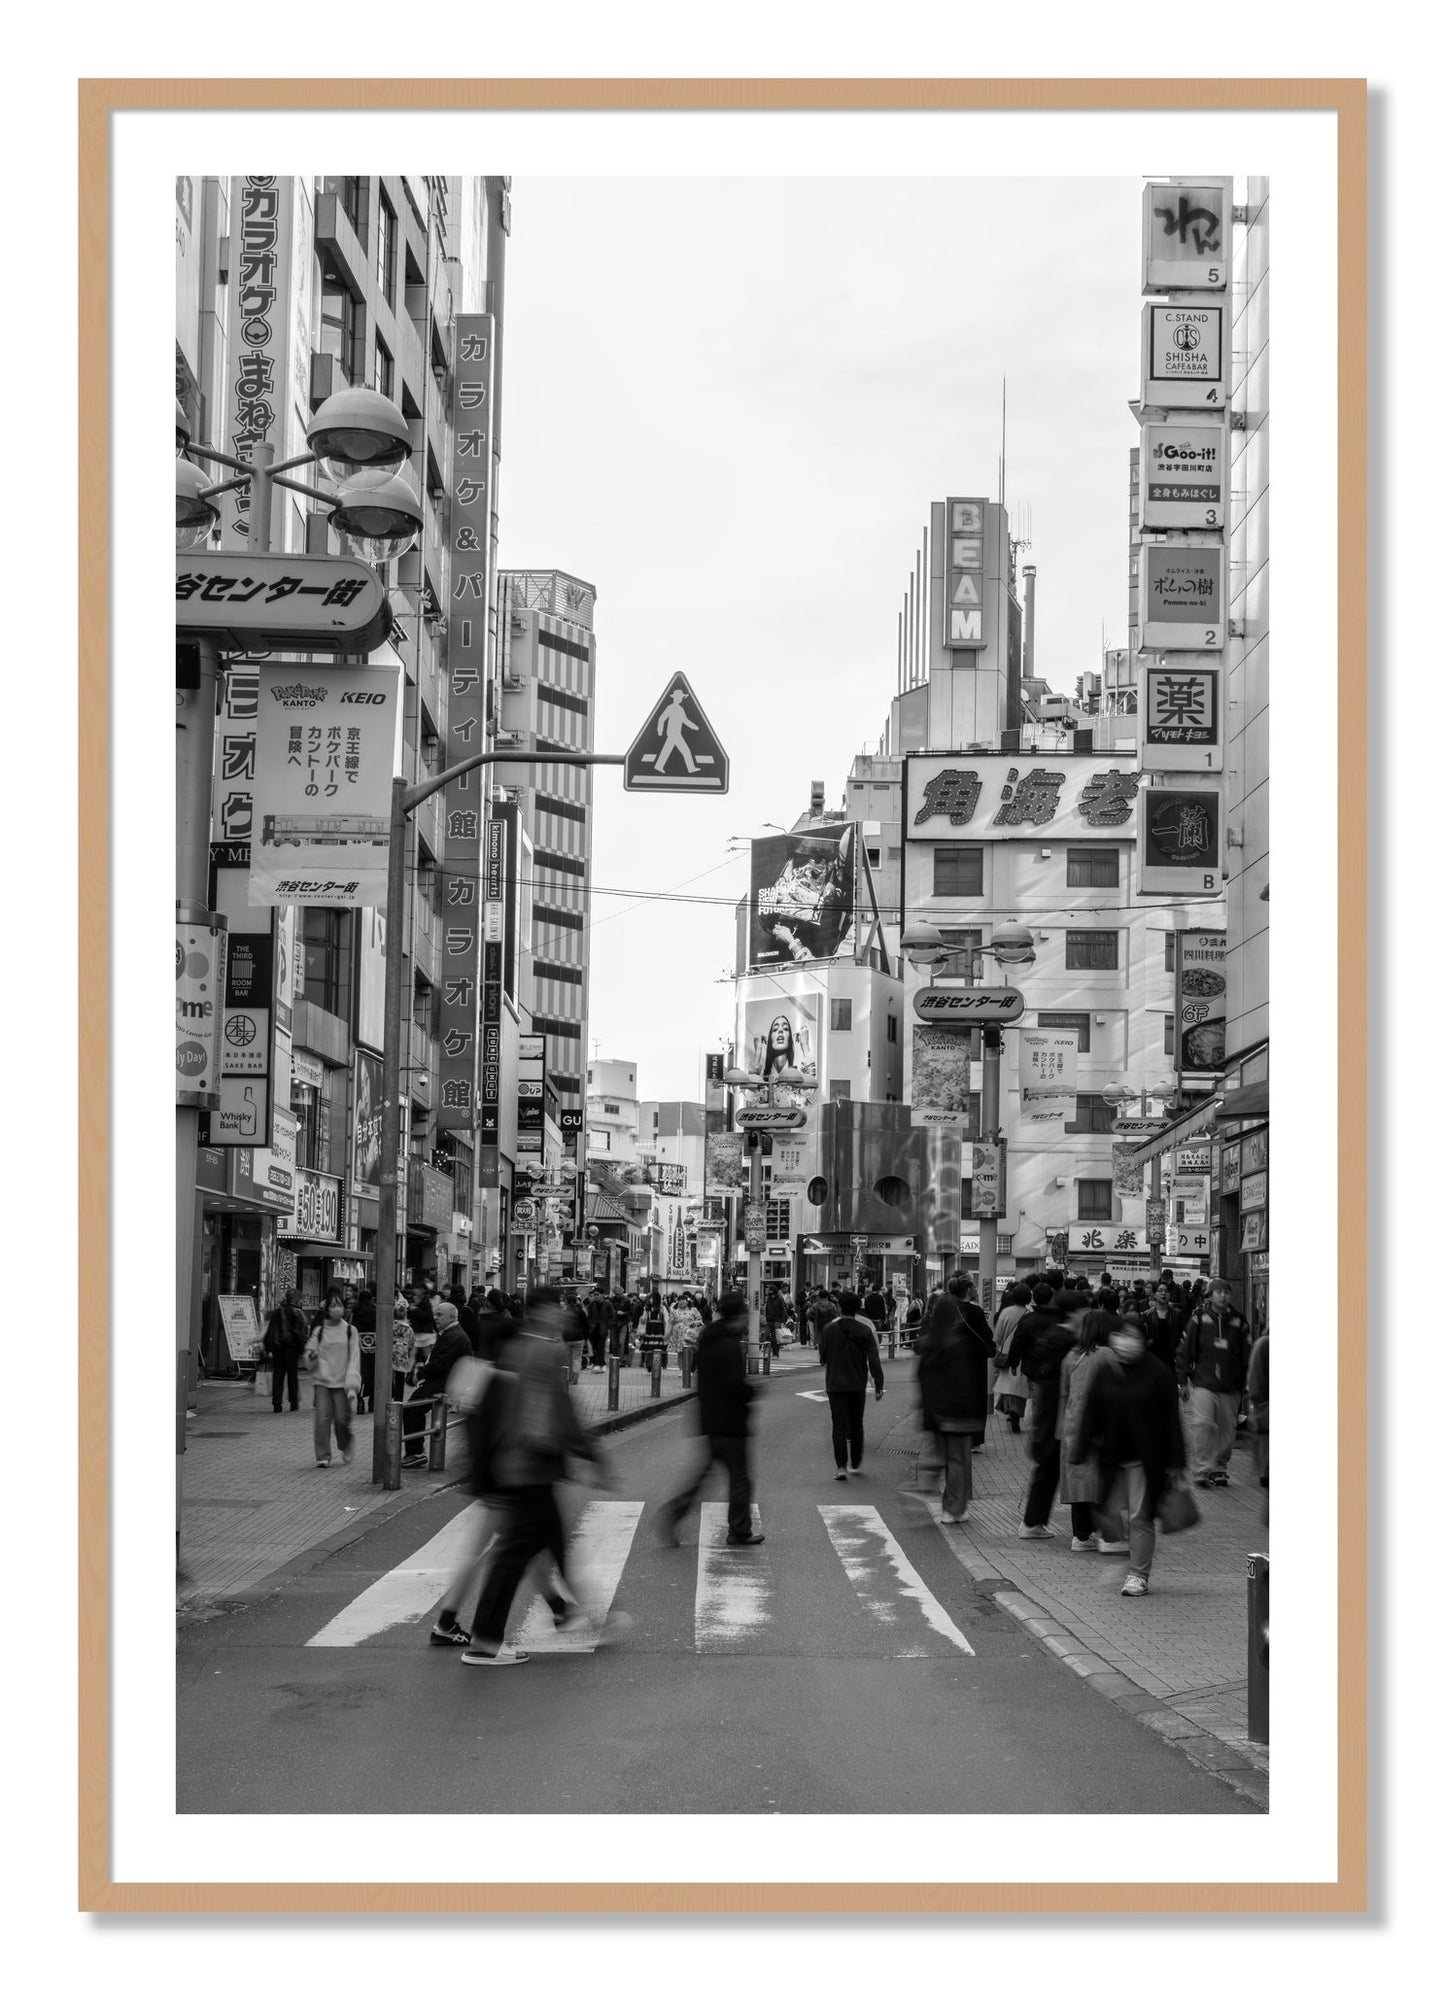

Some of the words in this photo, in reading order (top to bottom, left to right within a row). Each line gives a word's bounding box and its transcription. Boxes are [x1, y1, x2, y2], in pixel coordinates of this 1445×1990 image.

[240, 188, 279, 319] カラオケ
[1208, 268, 1220, 283] 5
[1165, 313, 1209, 322] C.STAND
[1165, 352, 1208, 362] SHISHA
[1164, 444, 1216, 460] Goo-it!
[1152, 488, 1217, 499] 全身もみほぐし
[1205, 509, 1217, 525] 3
[952, 503, 983, 640] BEAM
[1205, 630, 1216, 645] 2
[340, 692, 387, 705] KEIO
[1156, 676, 1205, 724] 薬
[288, 726, 303, 766] 冒険へ
[305, 726, 322, 797] カントーの
[324, 726, 342, 797] ポケパーク
[345, 727, 361, 784] 京王線で
[1204, 752, 1213, 767] 1
[914, 768, 1141, 826] 角海老
[1151, 805, 1209, 852] 一蘭
[491, 824, 499, 859] kimono
[275, 881, 360, 893] 渋谷センター街
[490, 864, 499, 896] hearts
[1203, 874, 1214, 889] B
[1184, 950, 1226, 961] 四川料理
[920, 996, 1018, 1009] 渋谷センター街
[1182, 1005, 1209, 1023] 6F
[187, 1050, 206, 1063] Day!
[220, 1112, 252, 1122] Whisky
[562, 1115, 582, 1126] GU
[219, 1121, 239, 1129] Bank
